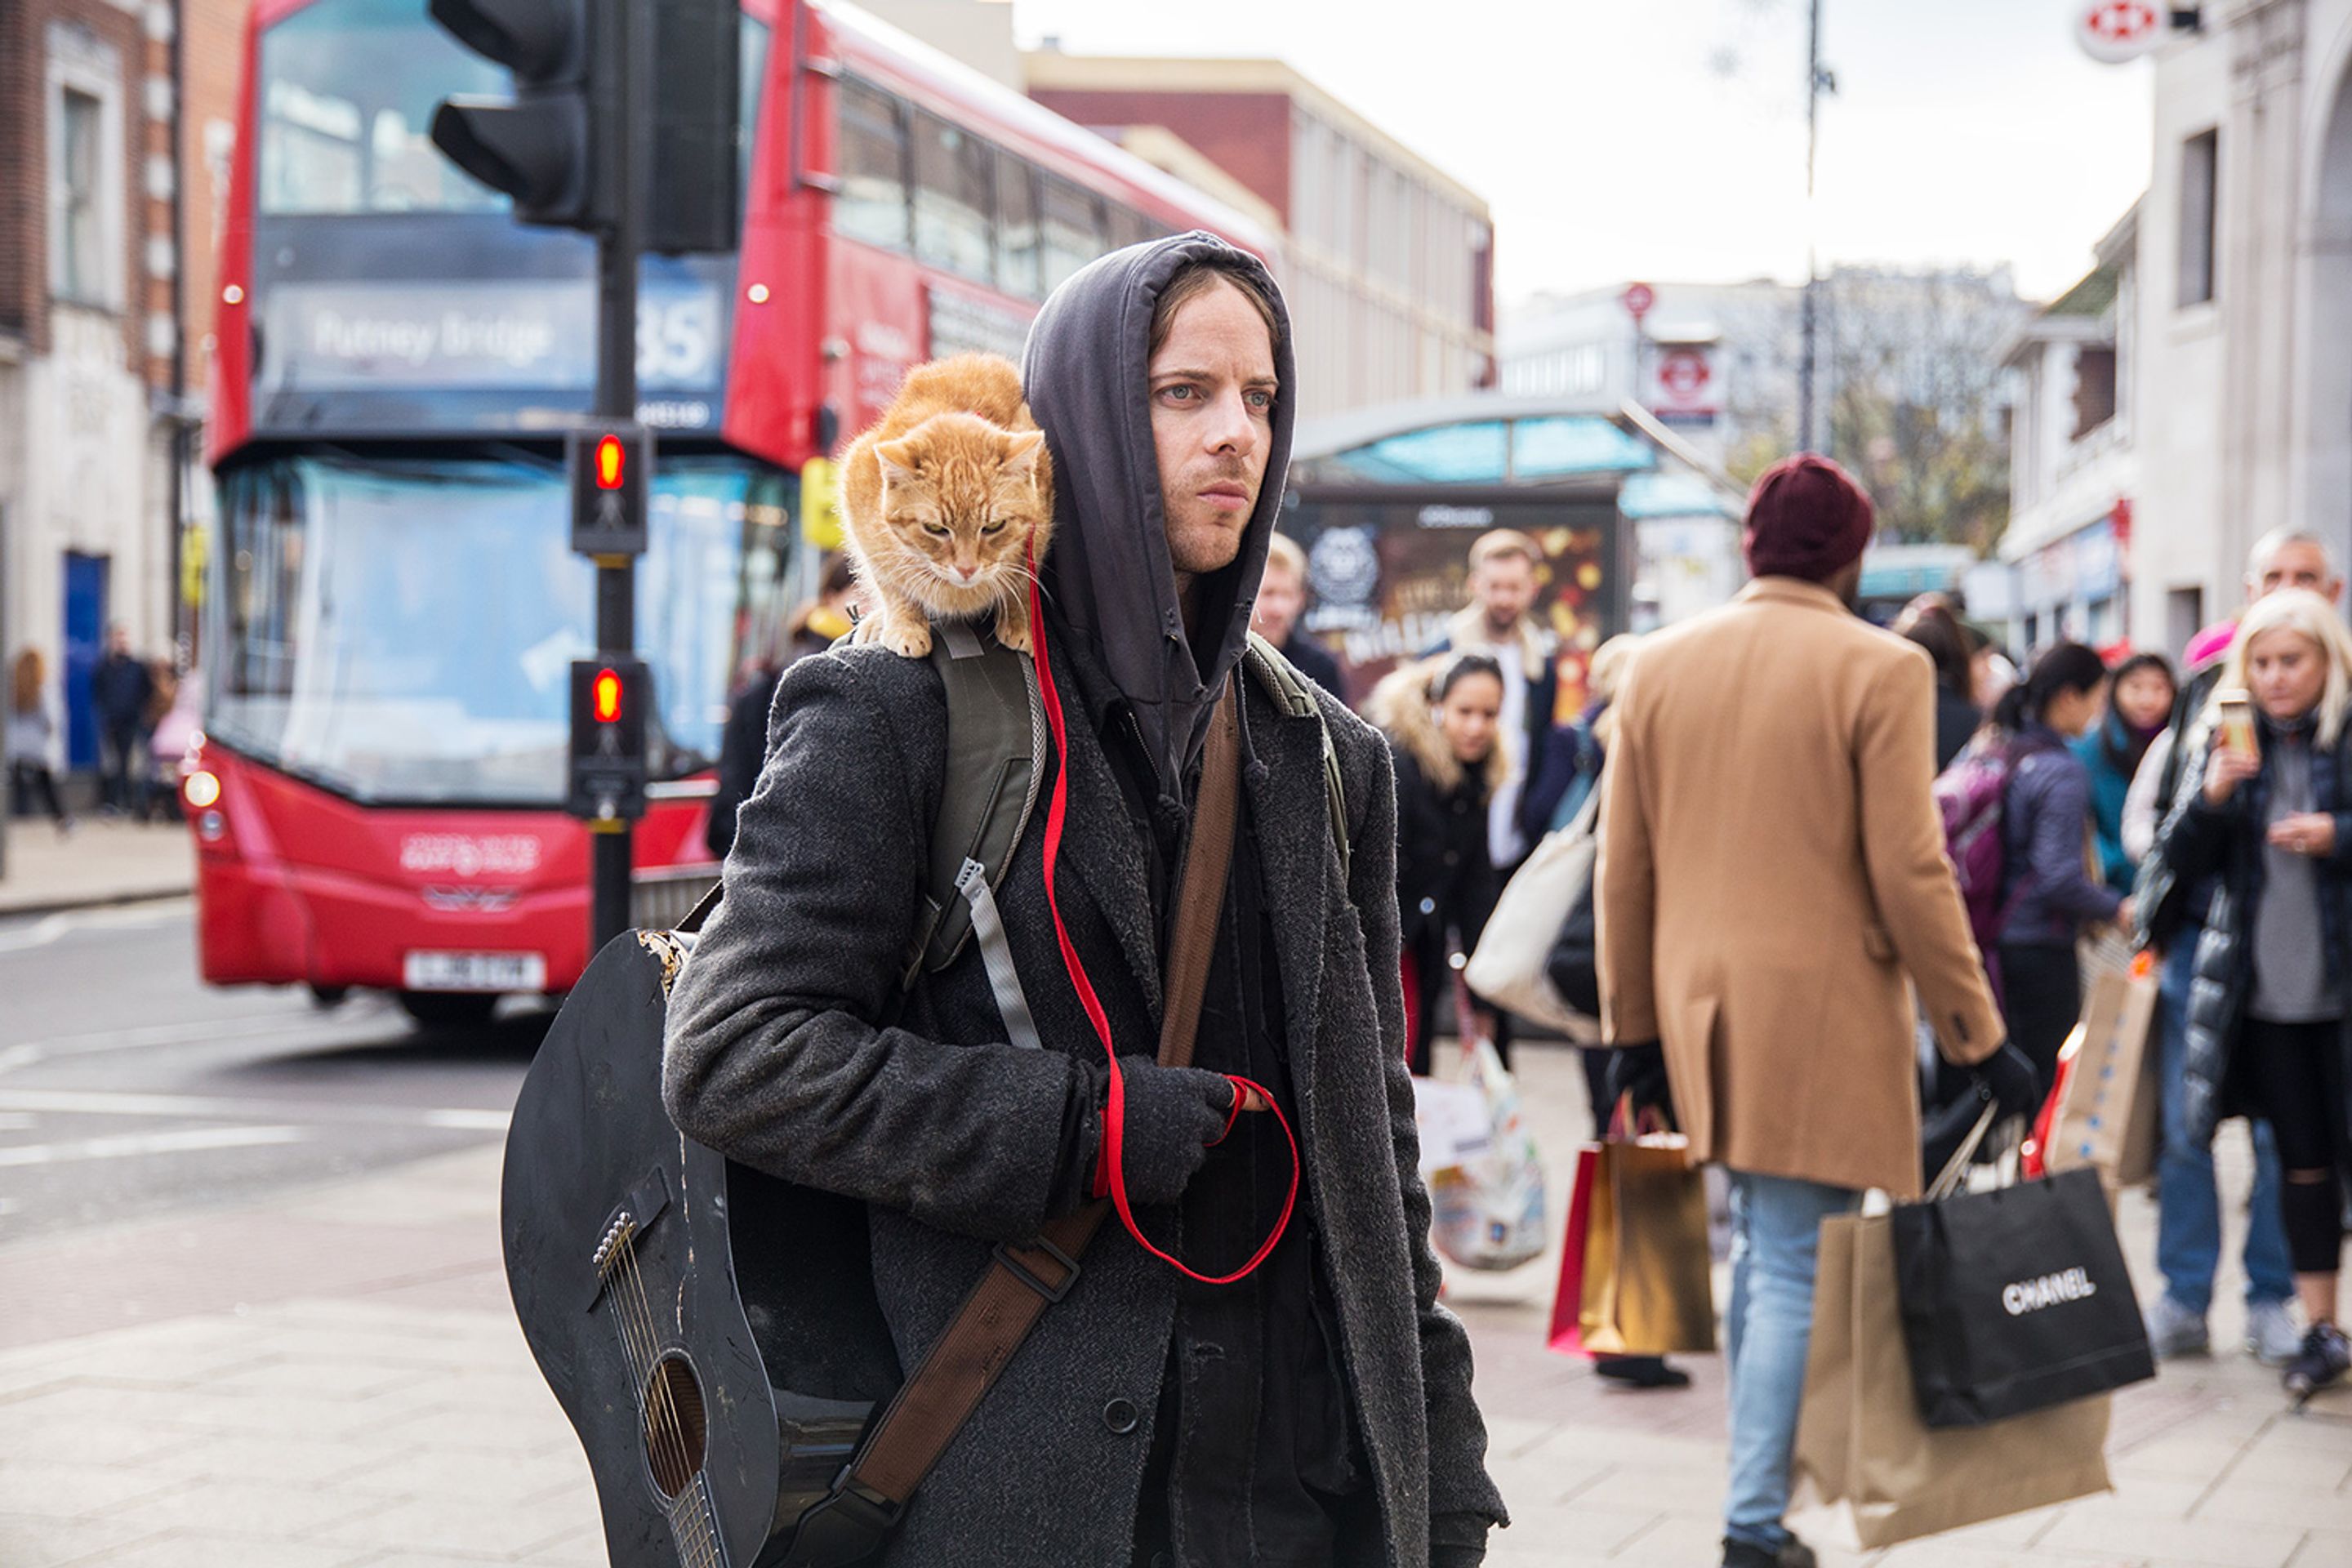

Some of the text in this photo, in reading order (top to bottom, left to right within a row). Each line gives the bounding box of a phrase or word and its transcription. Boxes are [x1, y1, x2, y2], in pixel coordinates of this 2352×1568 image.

[314, 310, 436, 366] Putney
[442, 310, 555, 367] Bridge
[2002, 1266, 2096, 1316] CHANEL
